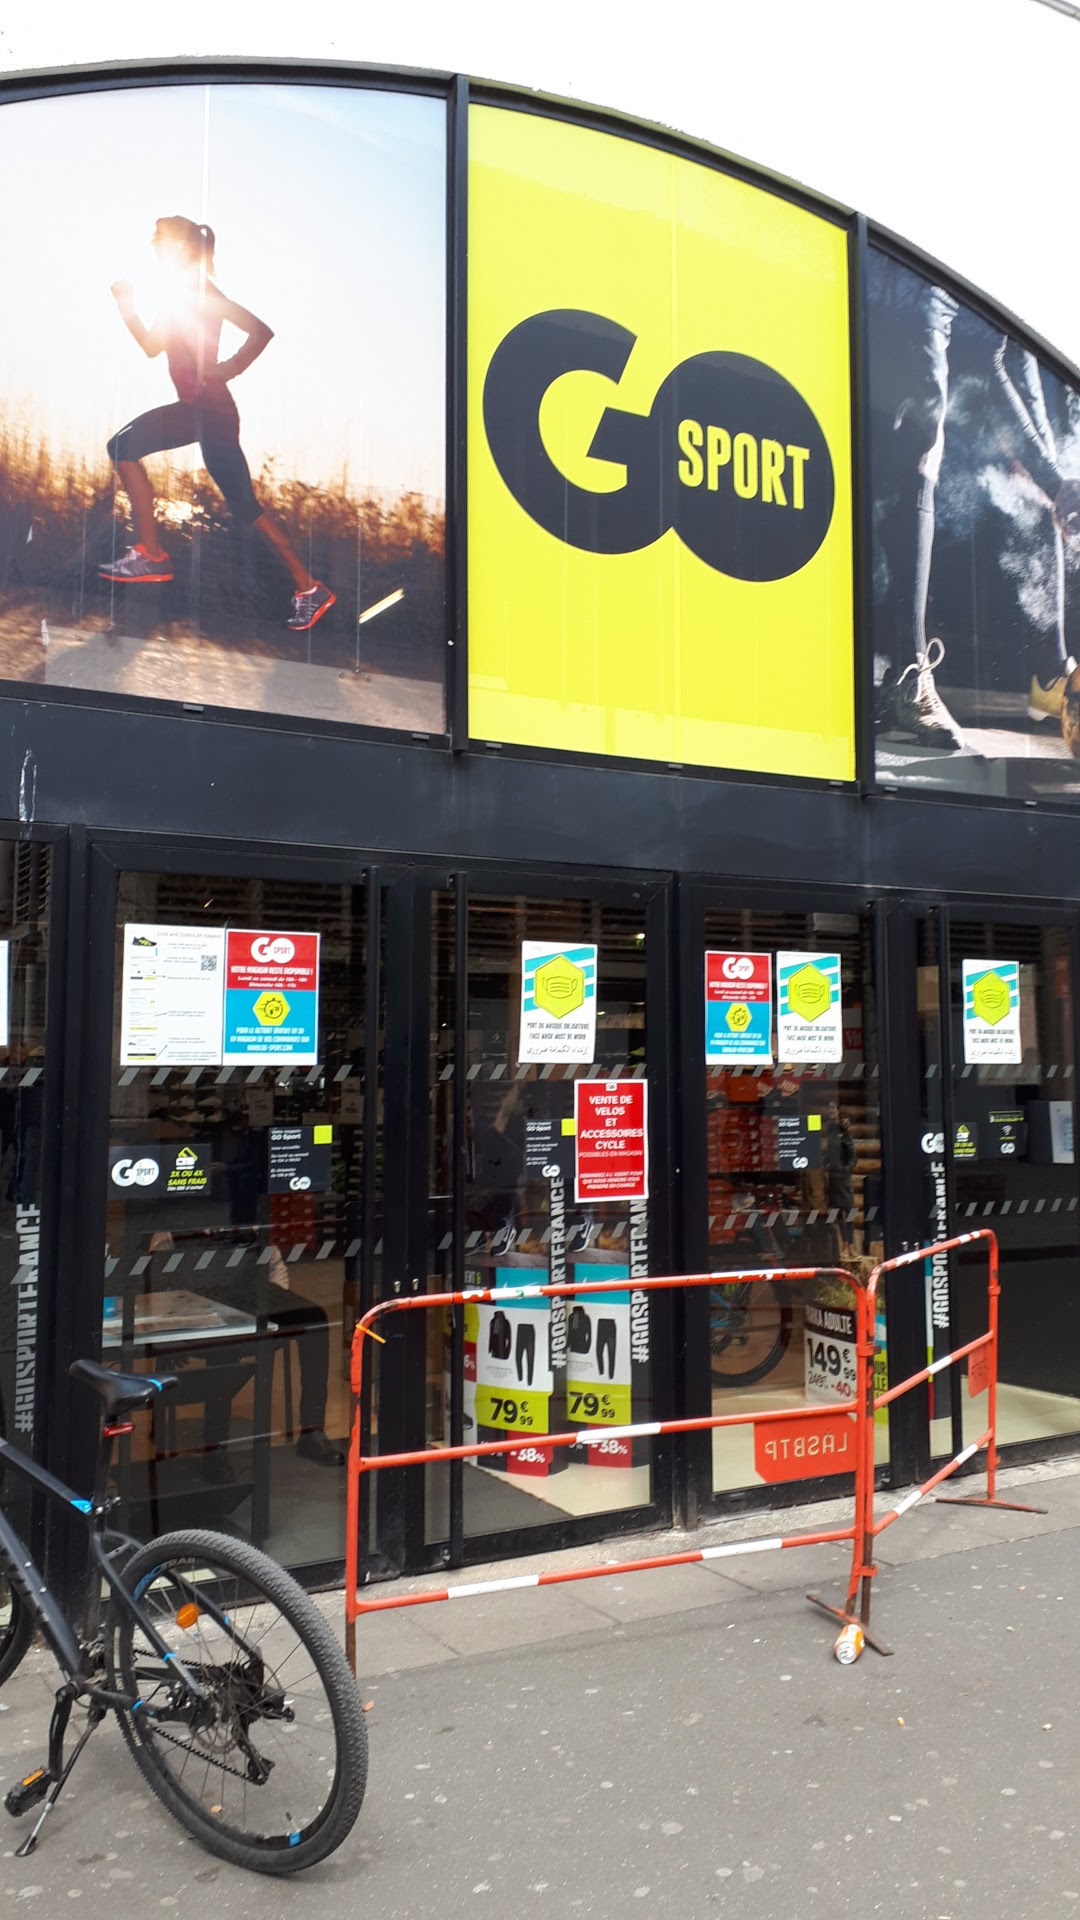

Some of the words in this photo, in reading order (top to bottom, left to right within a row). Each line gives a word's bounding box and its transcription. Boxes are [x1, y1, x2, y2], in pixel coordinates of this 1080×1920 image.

[482, 308, 835, 583] GO
[677, 418, 810, 510] SPORT
[250, 936, 296, 964] GO
[231, 966, 246, 974] VOTRE
[247, 966, 268, 975] MAGASIN
[588, 1096, 618, 1105] VENTE
[620, 1095, 633, 1104] DE
[595, 1106, 625, 1116] VELOS
[605, 1118, 618, 1127] ET
[282, 1133, 302, 1141] Sport
[580, 1128, 644, 1139] ACCESSOIRES
[595, 1140, 626, 1150] CYCLE
[618, 1150, 642, 1158] MAGASIN
[111, 1158, 160, 1187] GO
[136, 1167, 155, 1176] SPORT
[170, 1170, 180, 1178] 3X
[181, 1170, 193, 1178] OU
[167, 1178, 188, 1186] SANS
[188, 1178, 208, 1186] FRAIS
[550, 1177, 566, 1369] #GOSPRTFRANCE
[629, 1199, 650, 1363] #GOSPRTFRAN
[824, 1310, 853, 1335] ADULTE
[807, 1338, 842, 1376] 149
[568, 1391, 599, 1419] 79
[601, 1408, 616, 1419] 99
[490, 1397, 518, 1424] 79
[519, 1416, 534, 1426] 99
